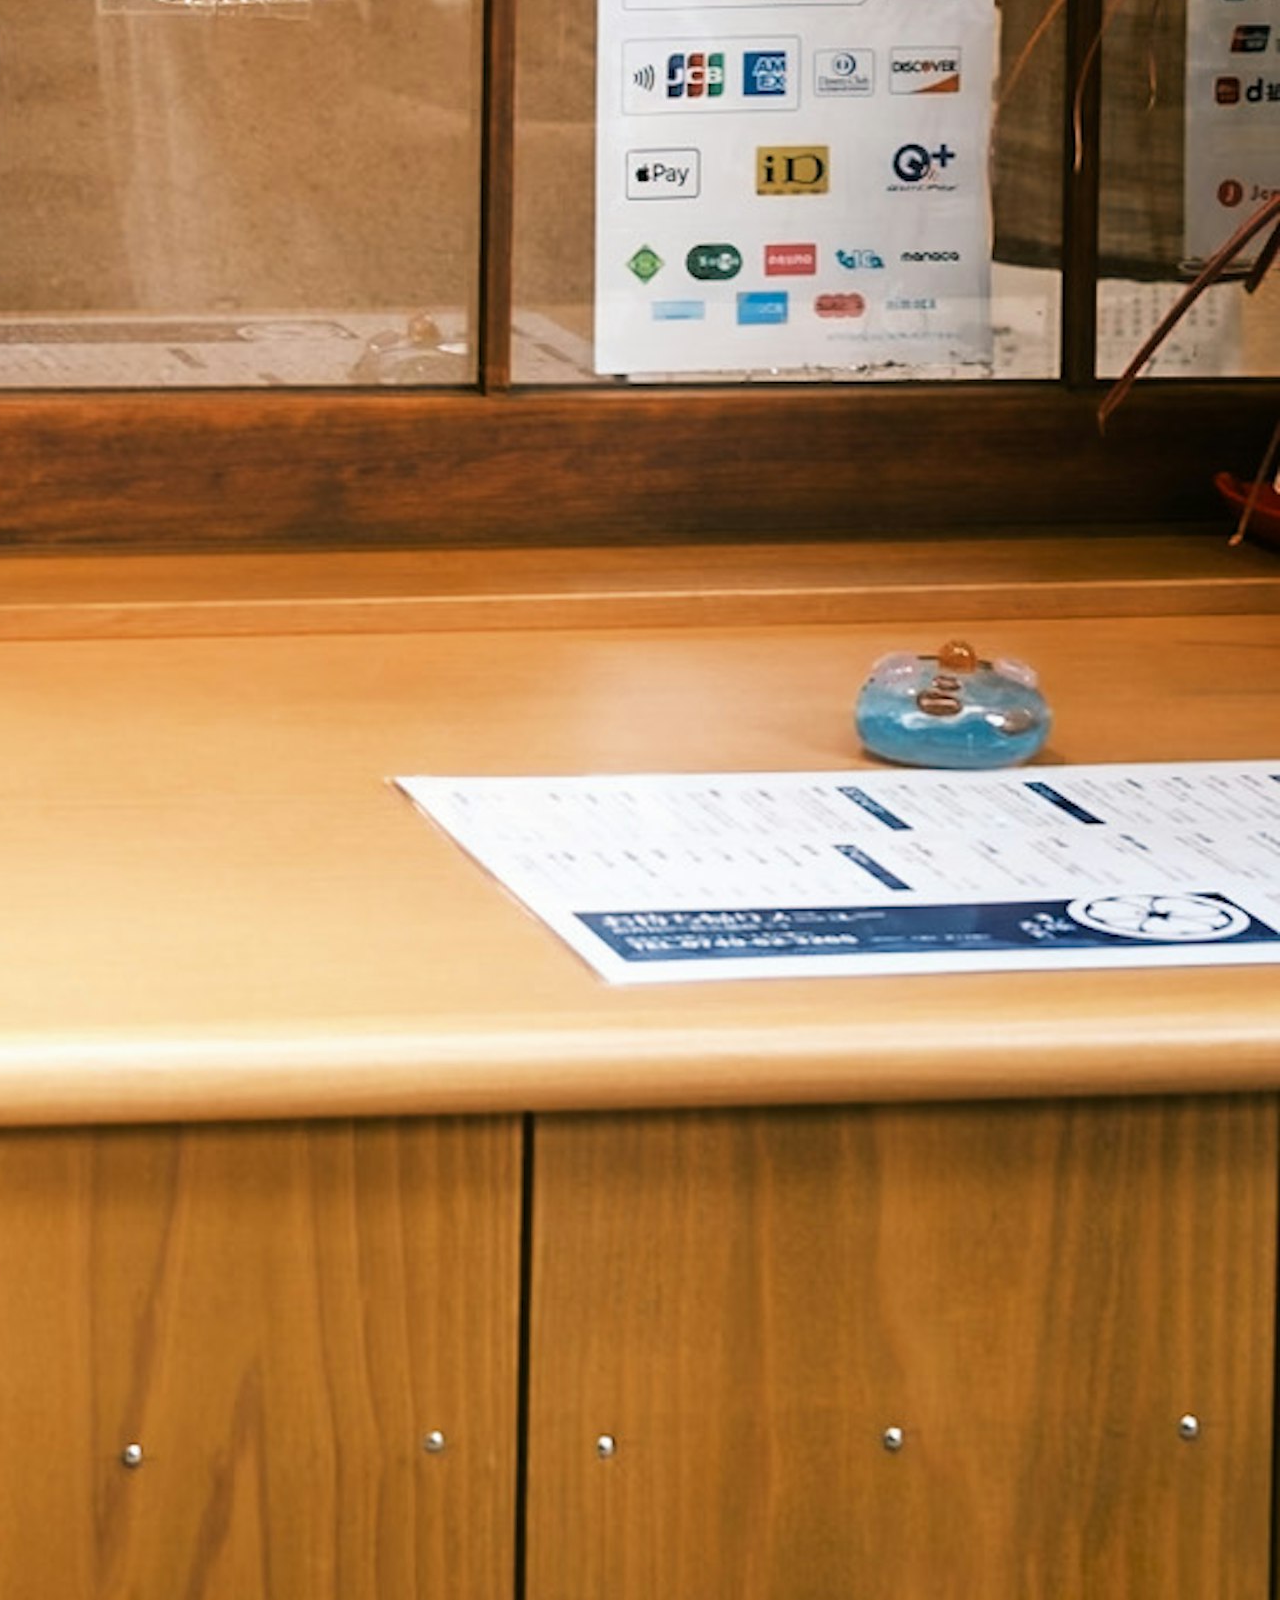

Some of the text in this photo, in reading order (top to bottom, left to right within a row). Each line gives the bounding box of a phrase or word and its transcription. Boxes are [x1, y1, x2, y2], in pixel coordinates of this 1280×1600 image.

[892, 59, 958, 73] DISCOVER
[653, 164, 690, 187] Pay
[764, 154, 825, 184] iD
[900, 250, 961, 263] manaca
